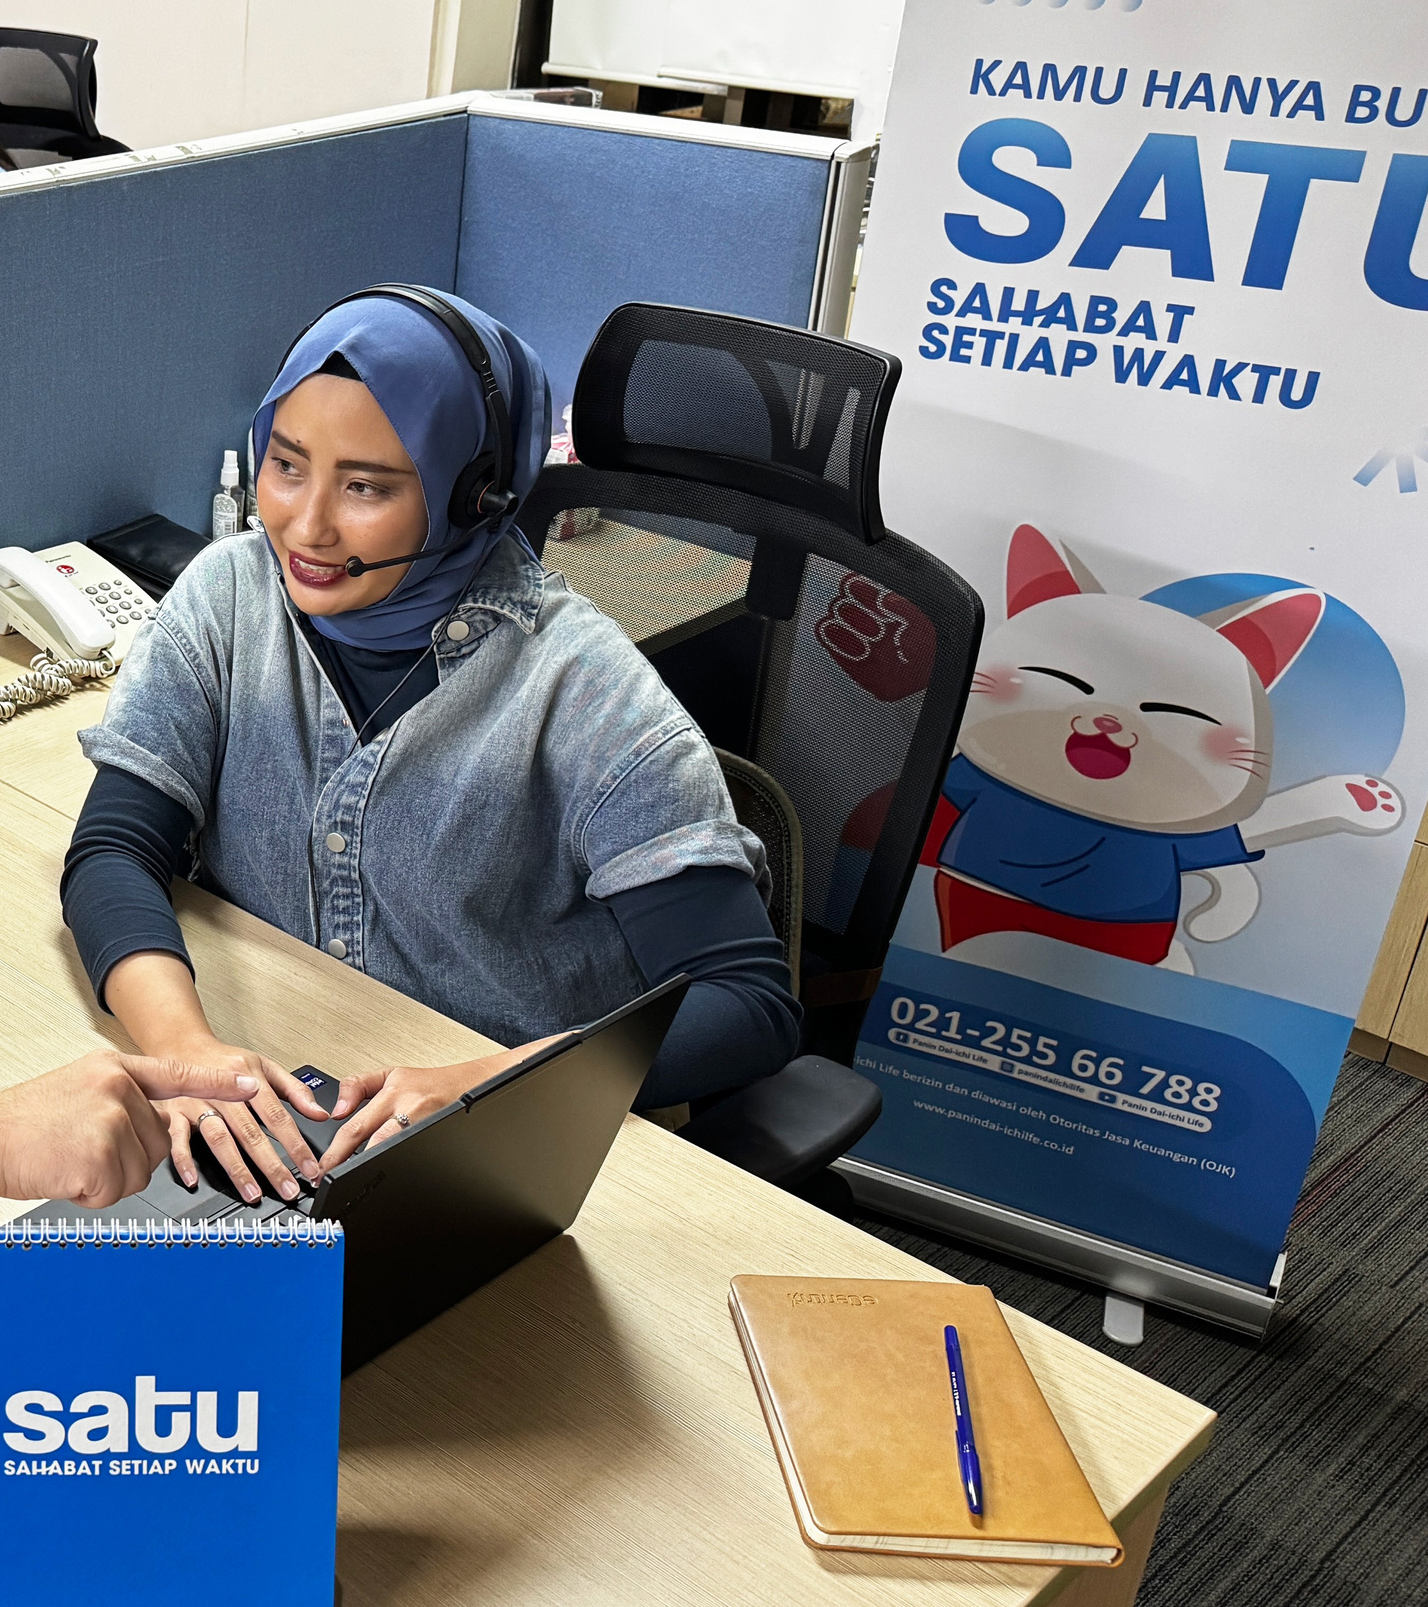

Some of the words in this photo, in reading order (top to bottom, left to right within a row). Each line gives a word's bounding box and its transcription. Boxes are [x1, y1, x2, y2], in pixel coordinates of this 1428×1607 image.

[969, 58, 1128, 106] KAMU
[1142, 69, 1326, 122] HANYA
[926, 277, 1196, 344] SAHABAT
[918, 322, 1098, 378] SETIAP
[1112, 344, 1322, 410] WAKTU
[890, 996, 1059, 1066] 021-255
[1071, 1049, 1125, 1085] 66
[1138, 1065, 1222, 1112] 788
[912, 1037, 937, 1051] Panin
[972, 1053, 989, 1065] Life
[879, 1062, 900, 1077] Life
[902, 1068, 943, 1089] berizin
[945, 1082, 968, 1096] dan
[971, 1089, 1017, 1111] diawasi
[1019, 1105, 1046, 1121] oleh
[1049, 1114, 1101, 1138] Otoritas
[1102, 1129, 1130, 1146] Jasa
[1133, 1138, 1198, 1166] Keuangan
[1200, 1157, 1237, 1179] (OJK)
[1122, 1098, 1148, 1114] Panin
[1150, 1105, 1185, 1124] Dai-ichi
[1187, 1117, 1205, 1129] Life
[2, 1375, 260, 1455] satu
[3, 1459, 103, 1476] SAHABAT
[108, 1459, 177, 1475] SETIAP
[185, 1458, 260, 1475] WAKTU
